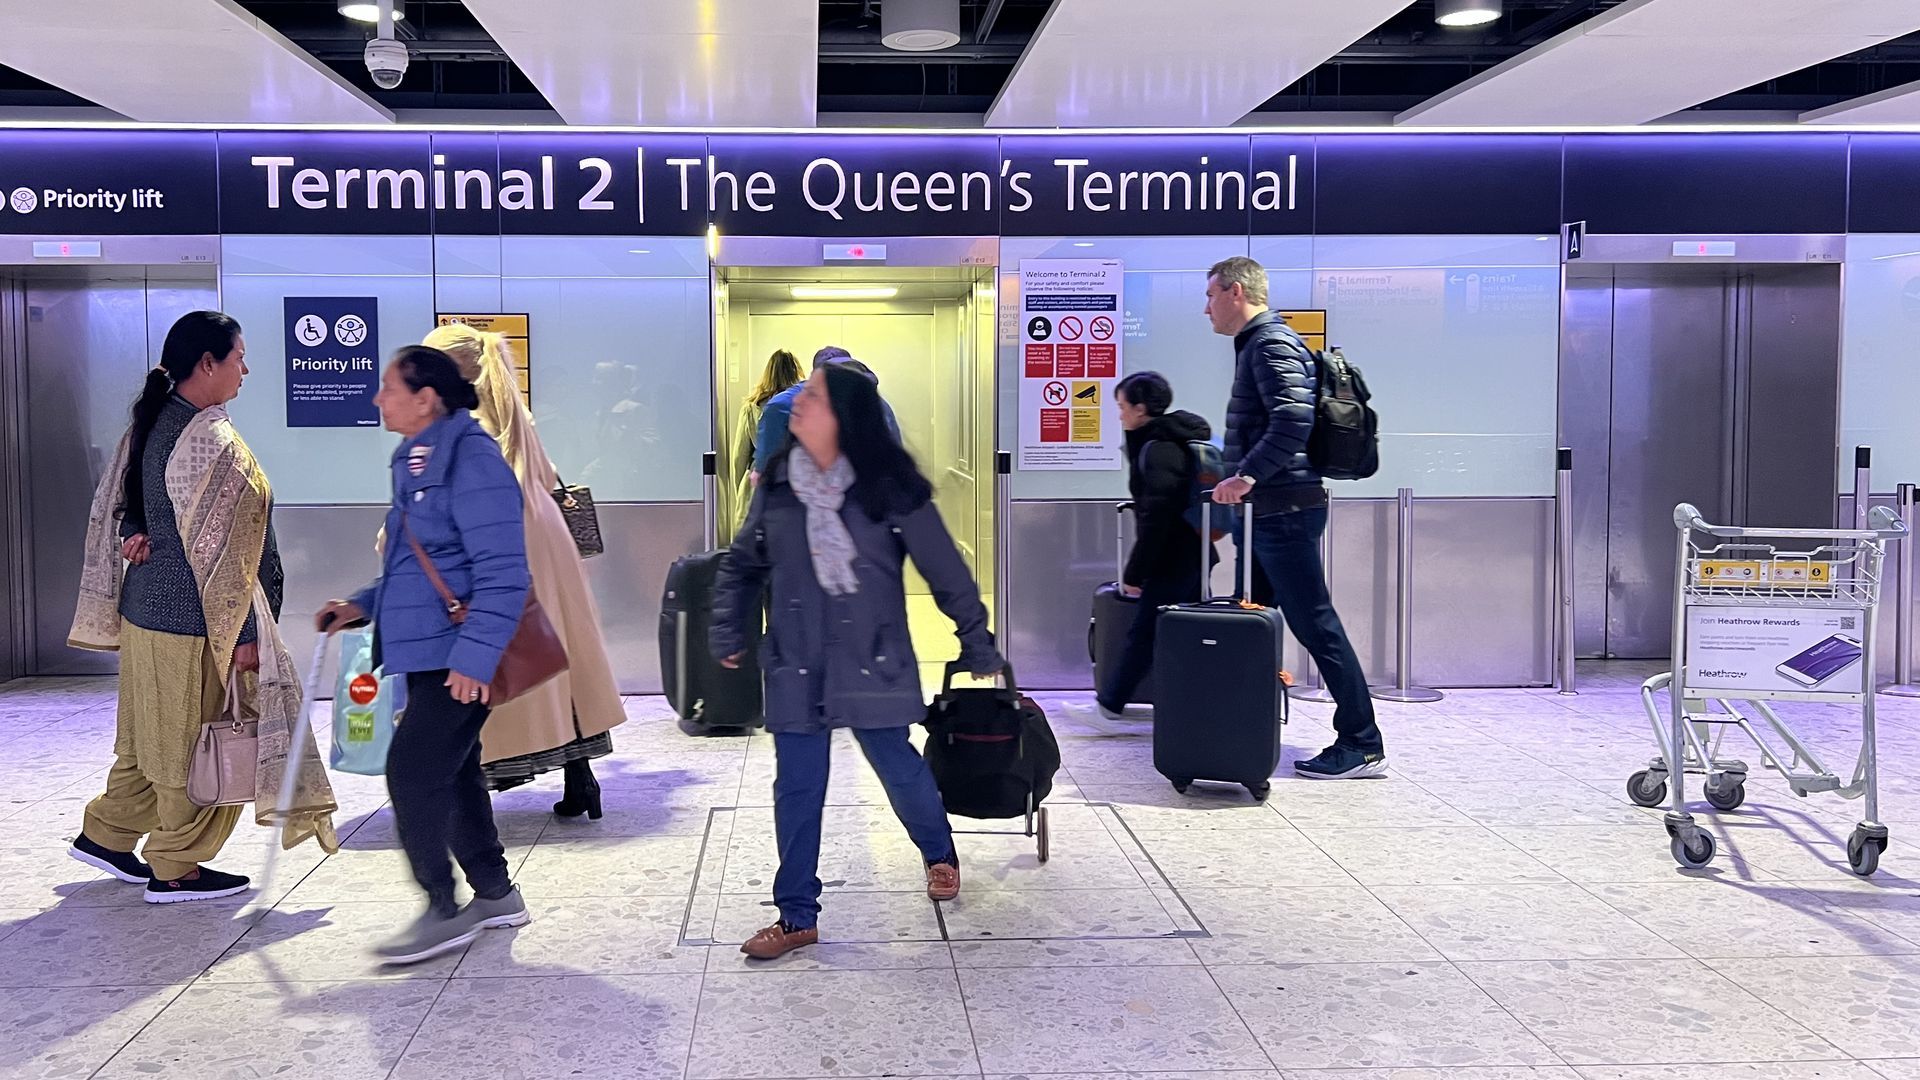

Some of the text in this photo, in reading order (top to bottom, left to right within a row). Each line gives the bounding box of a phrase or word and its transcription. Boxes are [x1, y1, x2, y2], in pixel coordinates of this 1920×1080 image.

[251, 154, 614, 210] Terminal 2
[667, 154, 1298, 220] The Queen’s Terminal
[44, 188, 164, 212] Priority lift
[292, 358, 372, 373] Priority lift
[1699, 669, 1747, 678] Heathrow
